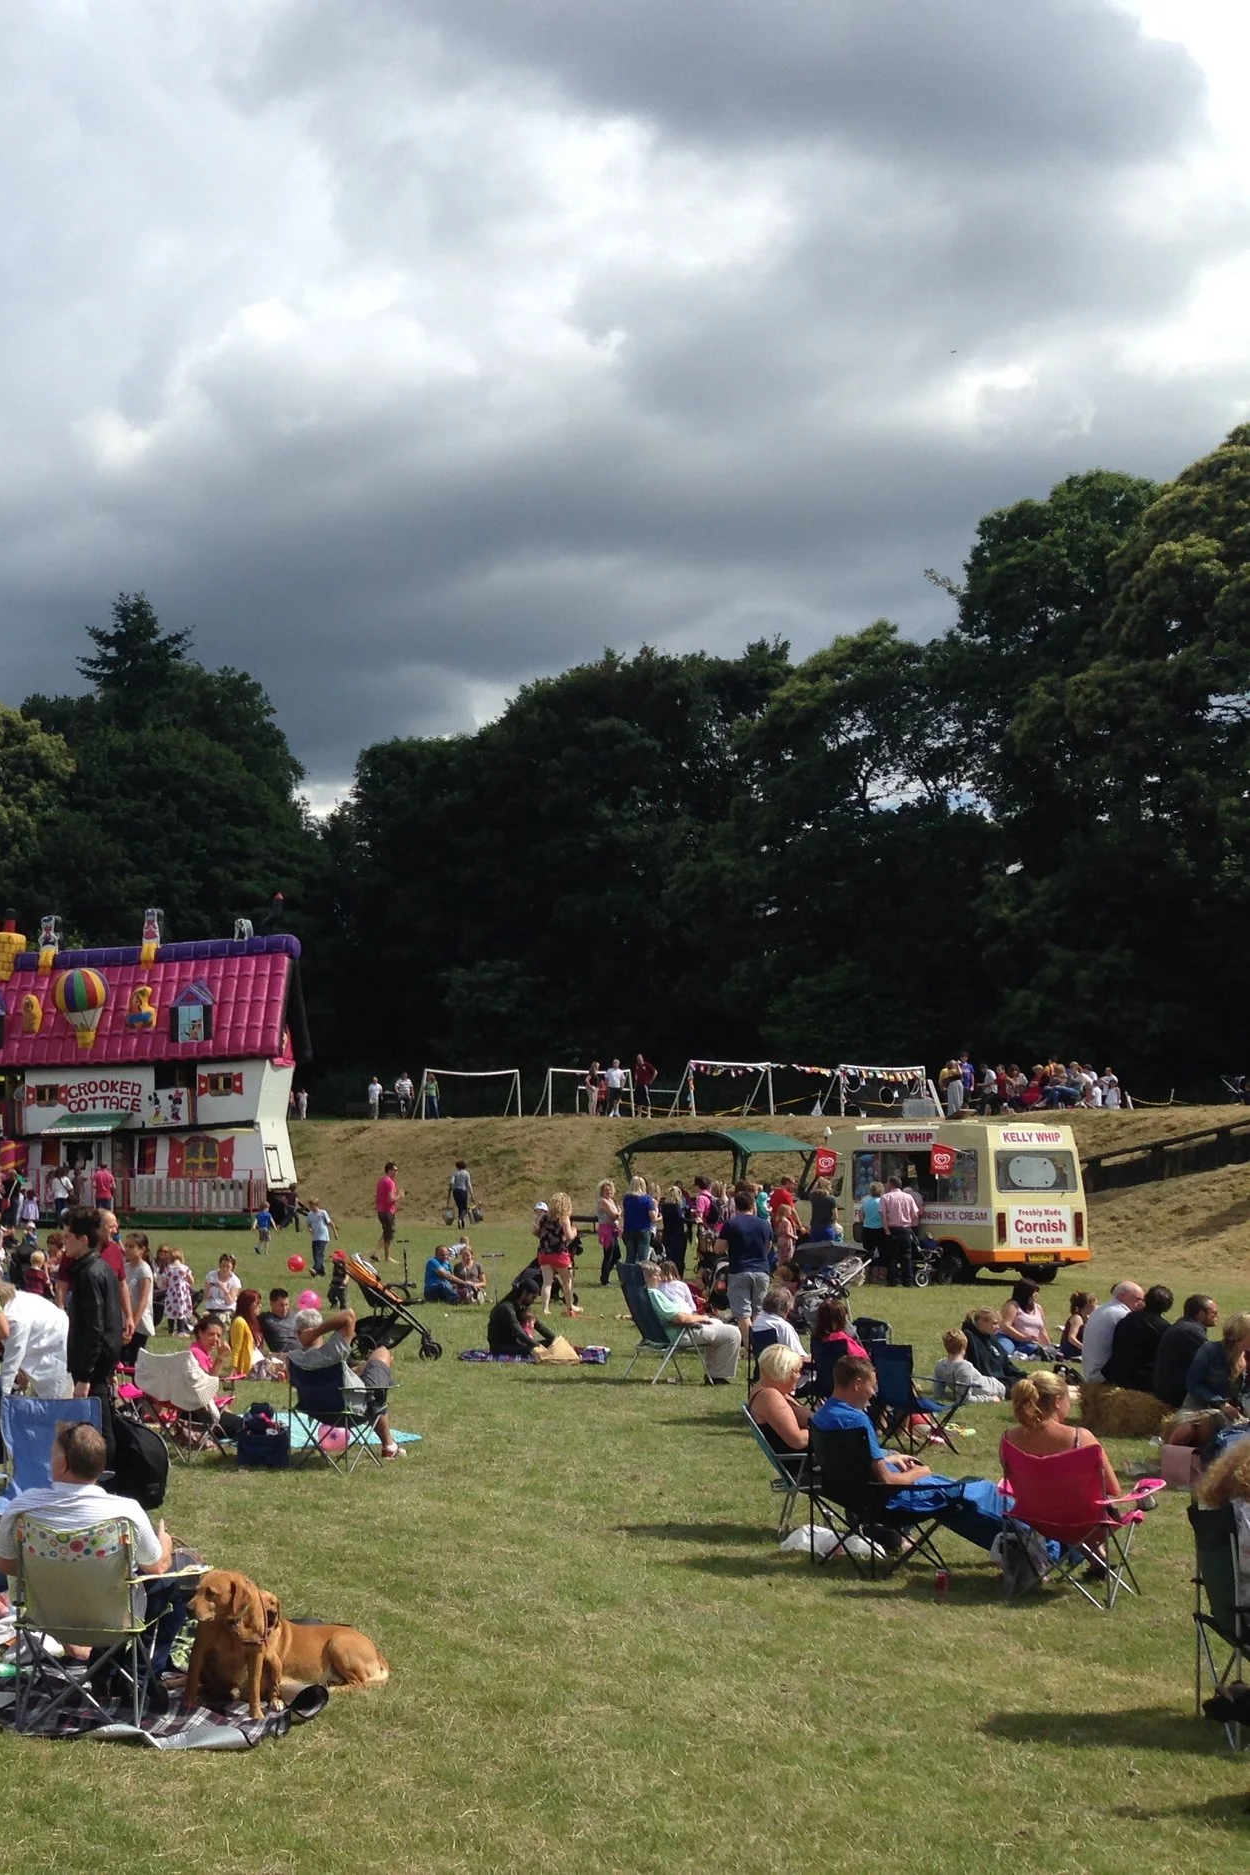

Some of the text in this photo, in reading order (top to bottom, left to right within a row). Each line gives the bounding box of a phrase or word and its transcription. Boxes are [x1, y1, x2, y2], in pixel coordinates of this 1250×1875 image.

[68, 1079, 142, 1098] CROOKED
[67, 1096, 141, 1113] COTTAGE
[867, 1132, 933, 1144] KELLY WHIP
[1002, 1132, 1061, 1143] KELLY WHIP
[944, 1211, 956, 1220] ICE
[958, 1211, 988, 1221] CREAM
[1018, 1209, 1043, 1217] Freshly
[1014, 1219, 1067, 1233] Cornish
[1019, 1236, 1063, 1244] Ice Cream
